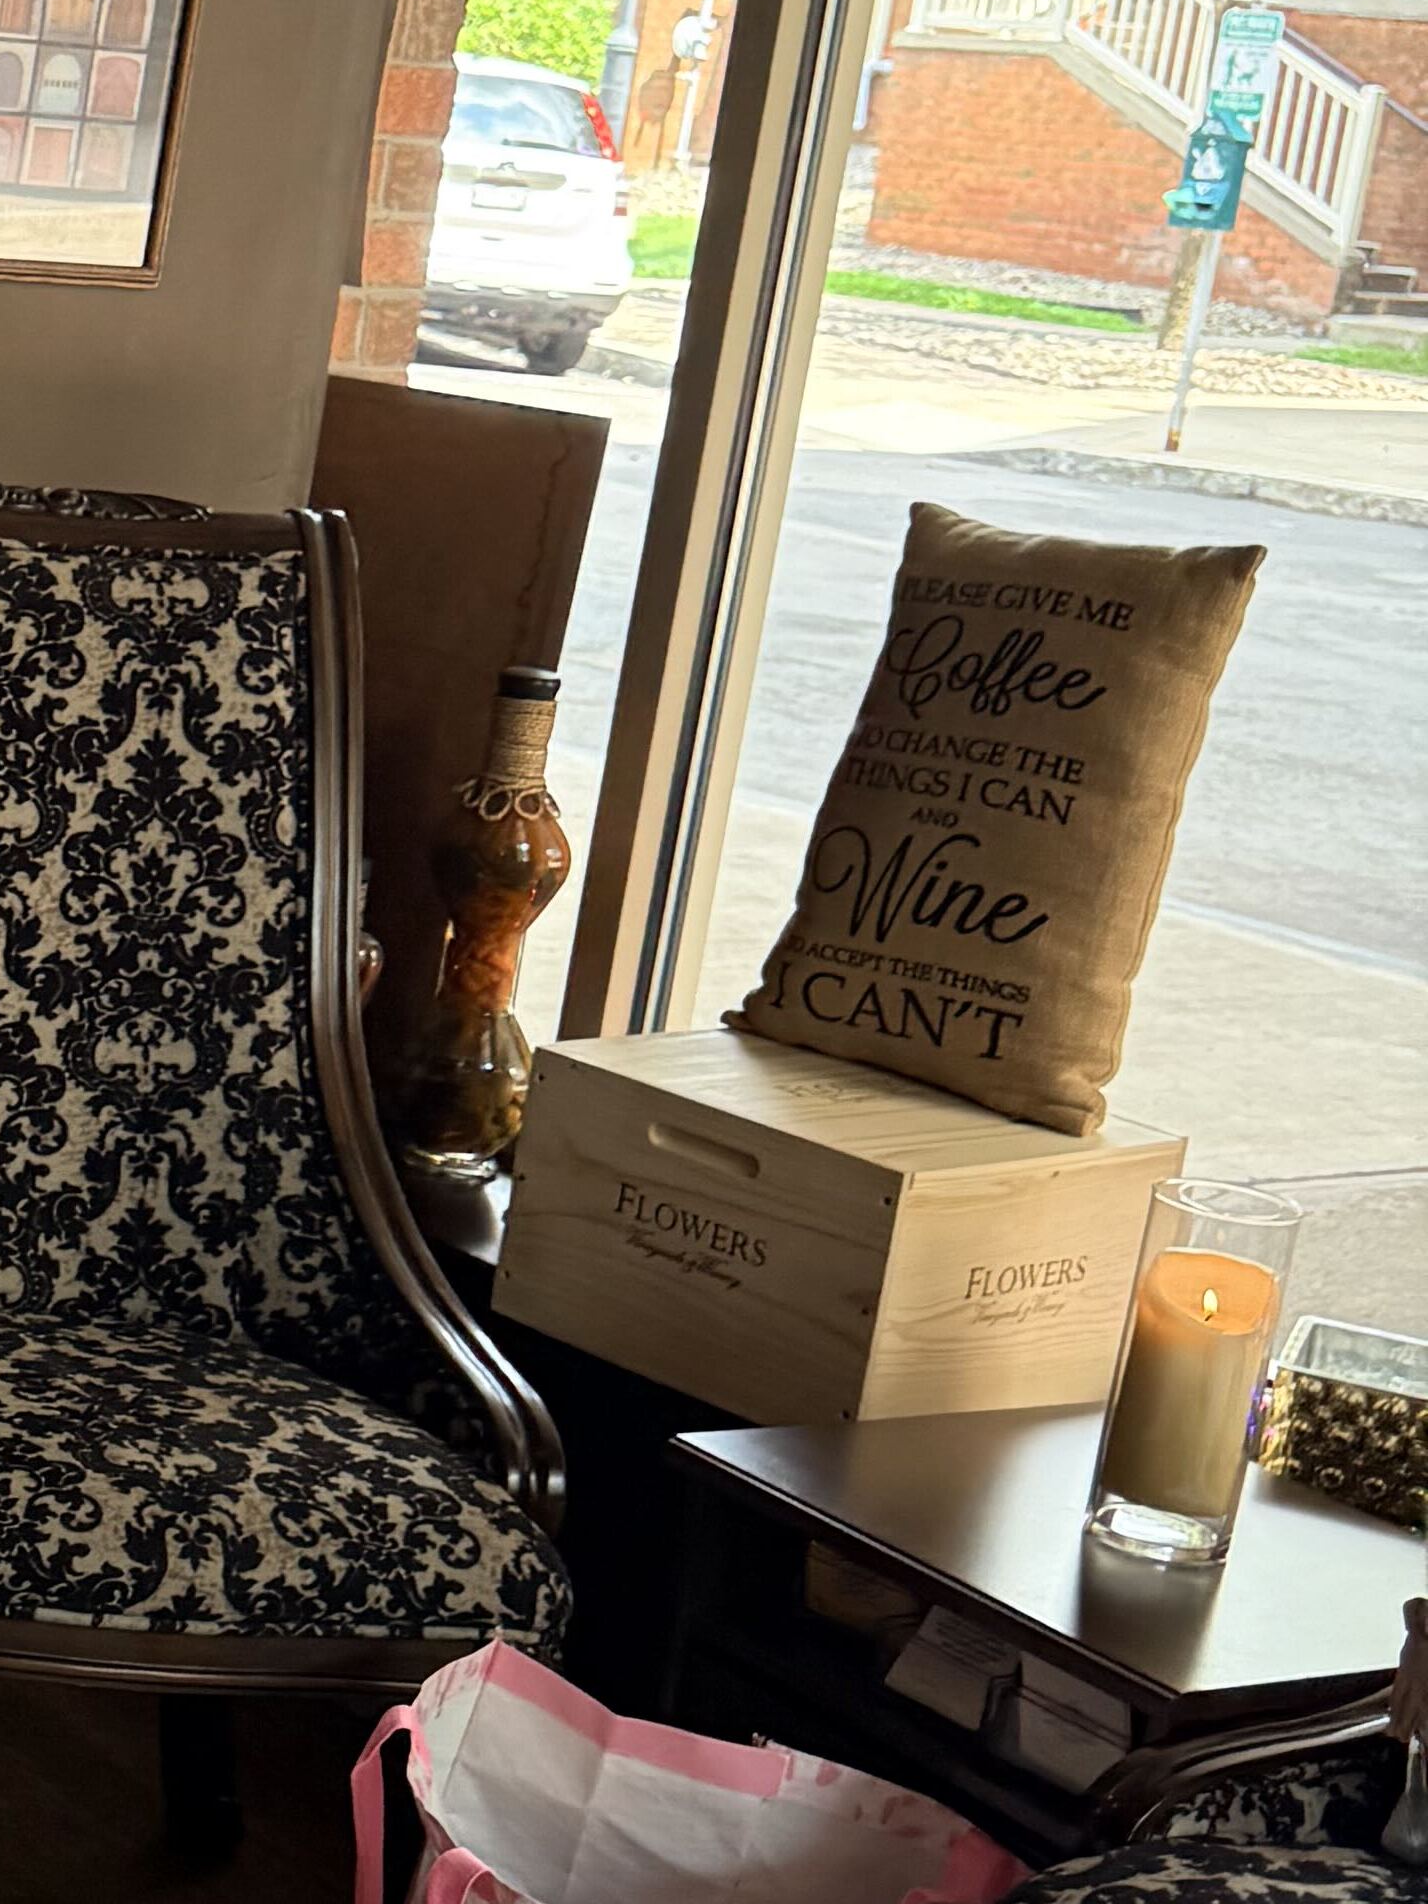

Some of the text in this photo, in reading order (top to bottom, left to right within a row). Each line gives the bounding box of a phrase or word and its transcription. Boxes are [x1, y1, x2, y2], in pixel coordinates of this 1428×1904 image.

[899, 577, 1135, 631] PLEASE GIVE ME
[886, 614, 1107, 720] Coffee
[844, 755, 1076, 826] THINGS I CAN
[886, 729, 1010, 767] CHANGE
[1014, 745, 1086, 785] THE
[910, 806, 958, 828] AND
[812, 826, 1049, 944] Wine
[806, 942, 884, 972] ACCEPT
[889, 957, 933, 982] THE
[937, 967, 1032, 1005] THINGS
[769, 961, 1024, 1059] I CAN'T
[613, 1181, 767, 1268] FLOWERS
[964, 1255, 1088, 1300] FLOWERS
